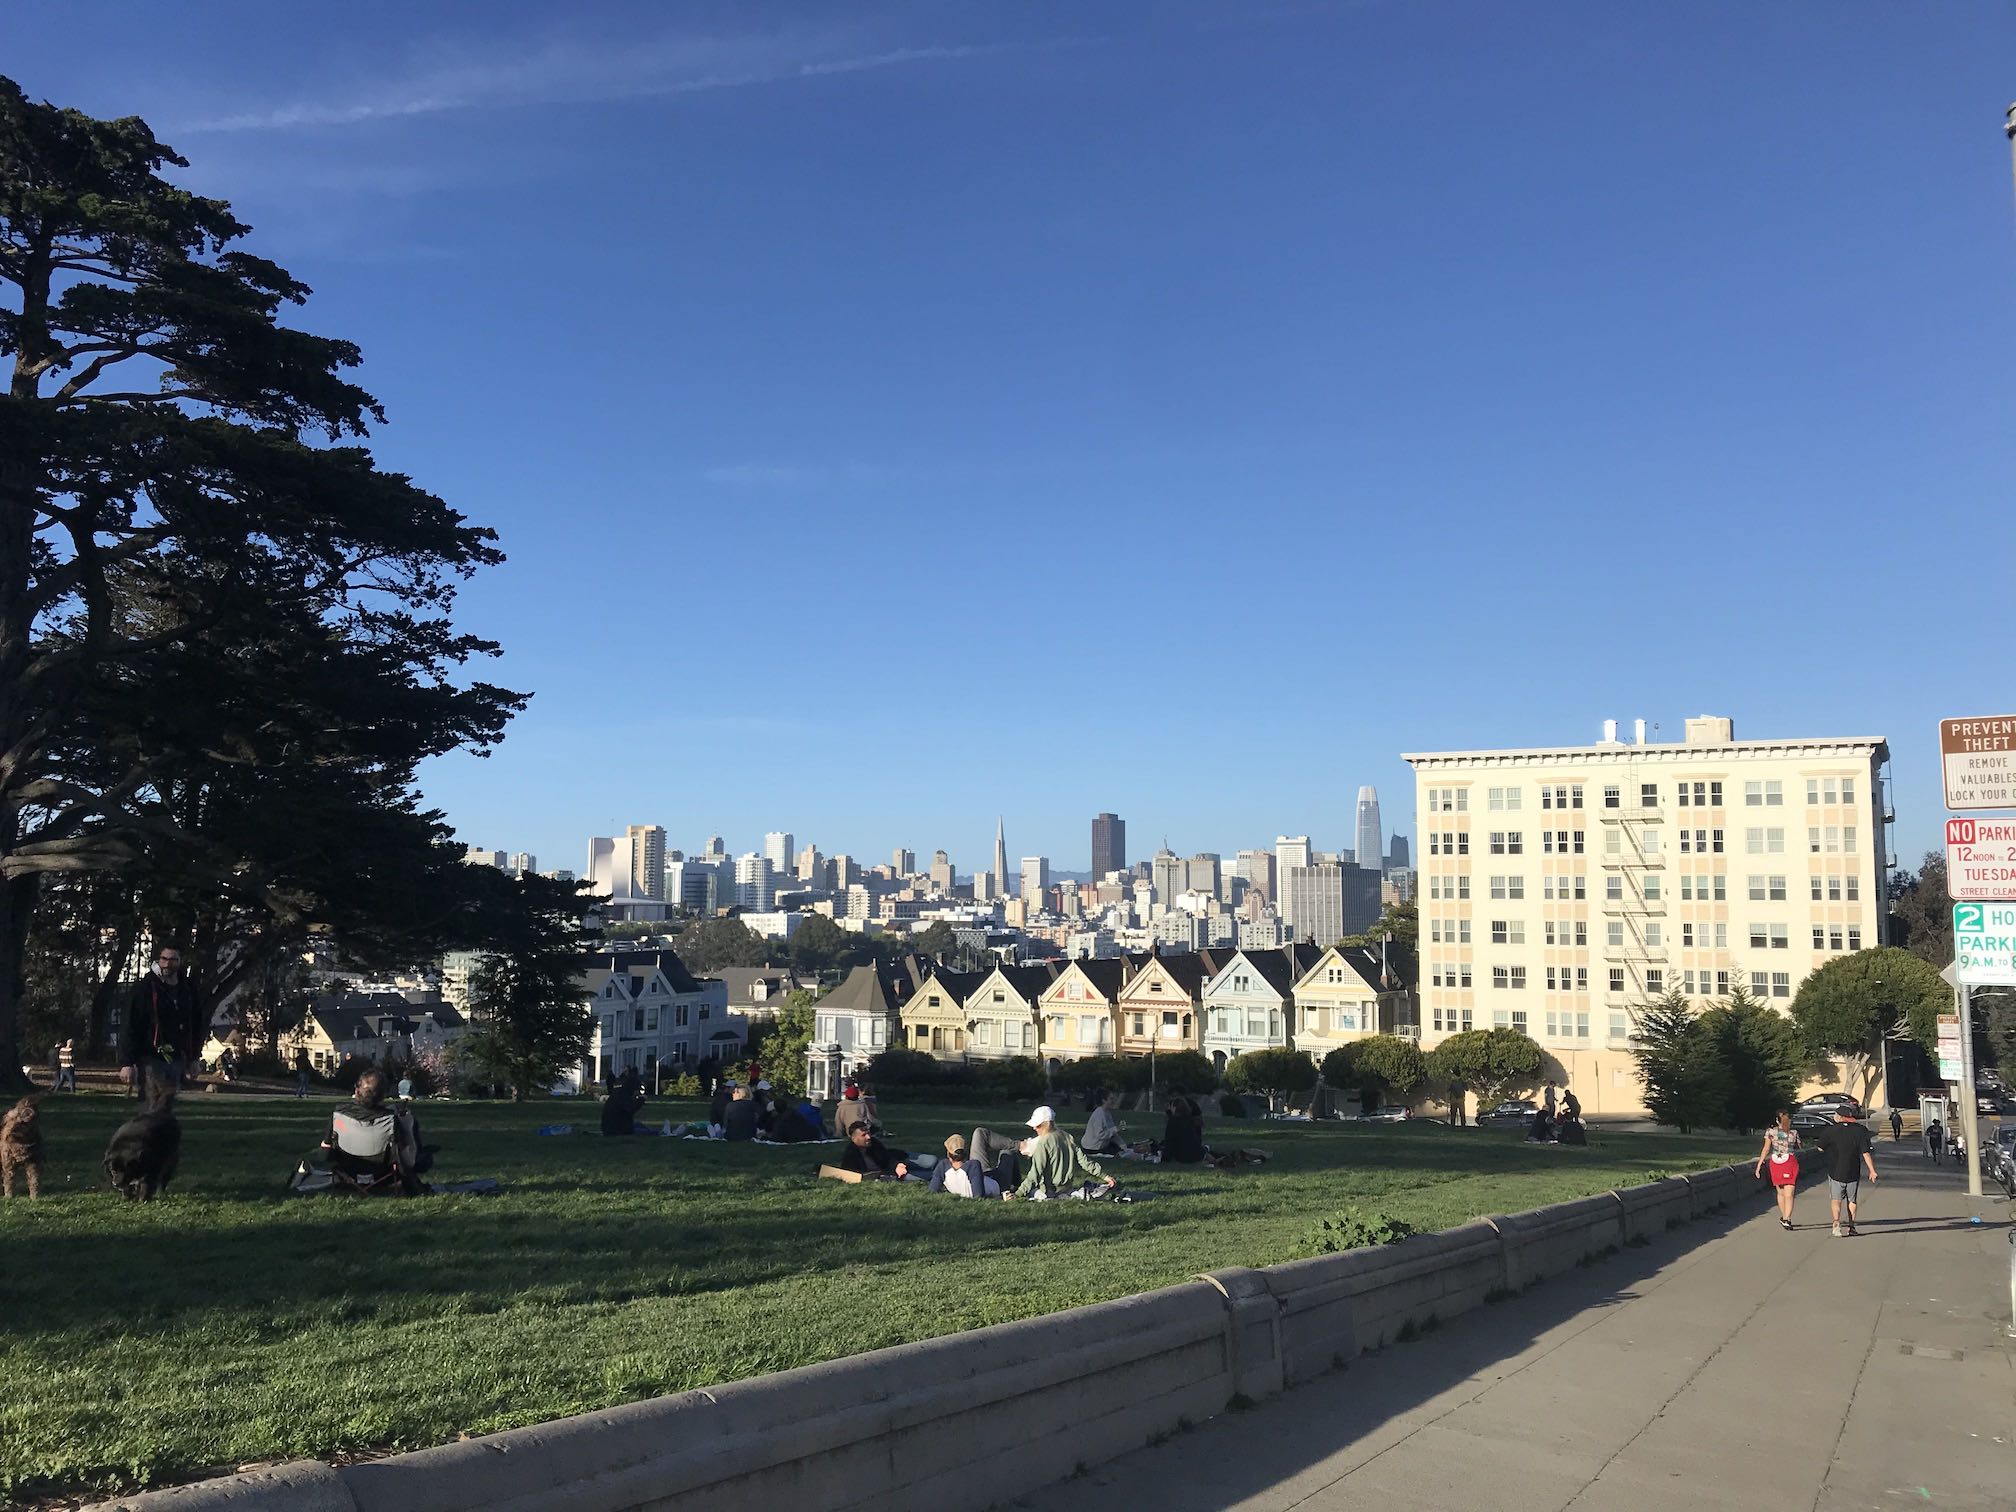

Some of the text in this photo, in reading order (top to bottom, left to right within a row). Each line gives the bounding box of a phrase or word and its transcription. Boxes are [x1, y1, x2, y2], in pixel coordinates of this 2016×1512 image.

[1963, 736, 2010, 752] THEFT
[1969, 758, 2008, 768] REMOVE
[1960, 773, 2016, 784] VALUABLES
[1950, 790, 1975, 801] LOCK
[1980, 789, 2007, 800] YOUR
[1949, 822, 1973, 842] NO
[1957, 847, 1972, 862] 12
[1973, 854, 1995, 862] NOON
[2007, 847, 2016, 862] 2
[1964, 869, 2016, 880] TUESDA
[1960, 888, 1989, 896] STREET
[1958, 906, 2014, 931] 2 HO
